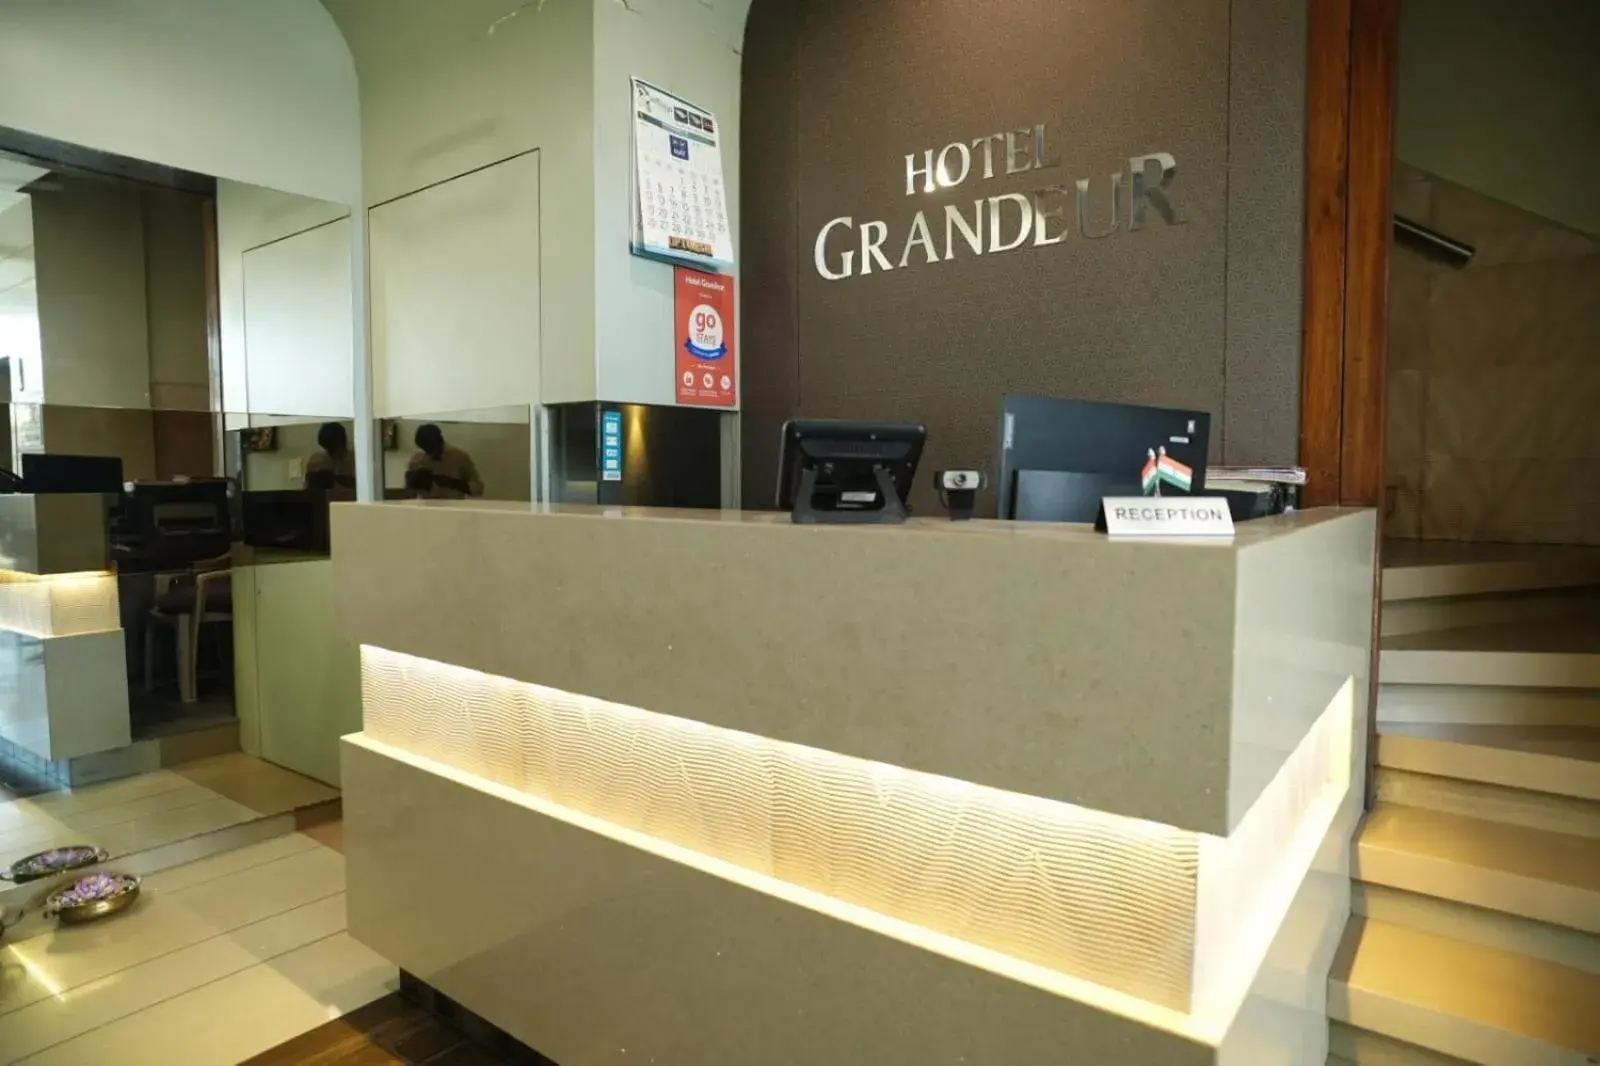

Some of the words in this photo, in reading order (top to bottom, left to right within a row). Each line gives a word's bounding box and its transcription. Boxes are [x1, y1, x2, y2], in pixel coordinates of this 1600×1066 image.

[904, 123, 1061, 196] HOTEL
[814, 152, 1189, 281] GRANDEUR
[696, 312, 716, 333] go
[1114, 506, 1223, 521] RECEPTION
